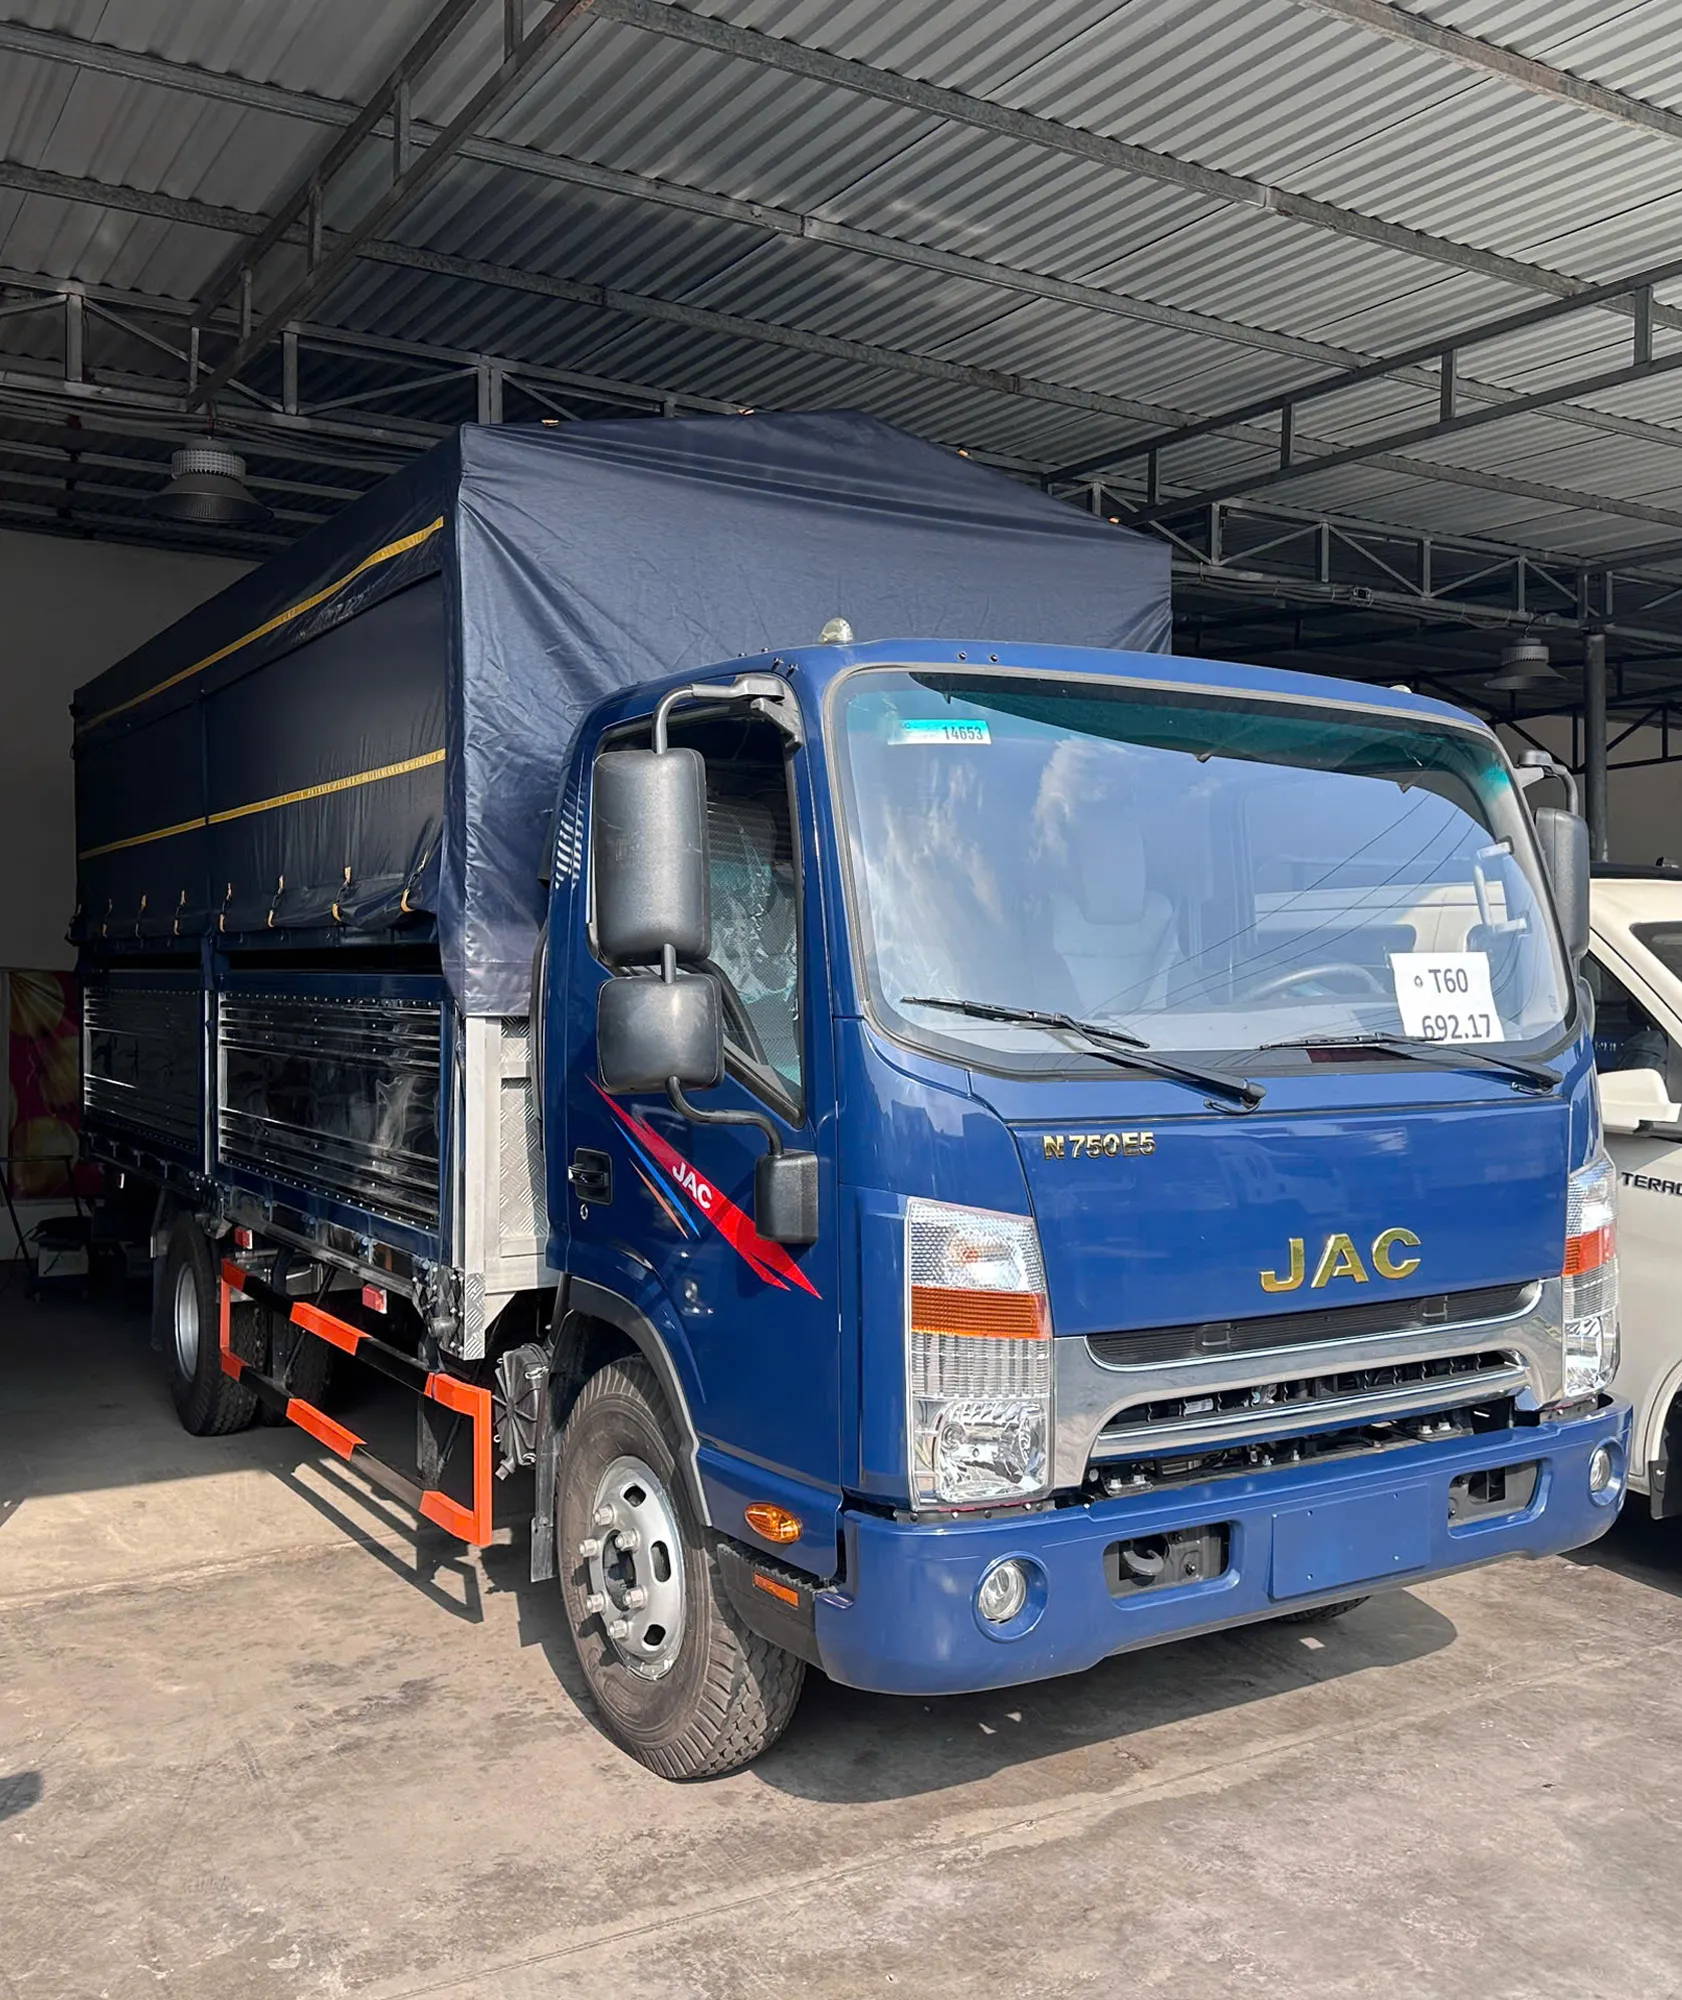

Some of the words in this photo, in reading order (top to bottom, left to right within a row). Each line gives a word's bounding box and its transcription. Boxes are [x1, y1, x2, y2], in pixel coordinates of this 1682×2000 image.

[942, 725, 983, 740] 14653
[1428, 968, 1468, 993] T60
[1422, 1014, 1490, 1040] 692.17
[672, 1162, 712, 1209] JAC
[1258, 1227, 1422, 1293] JAC
